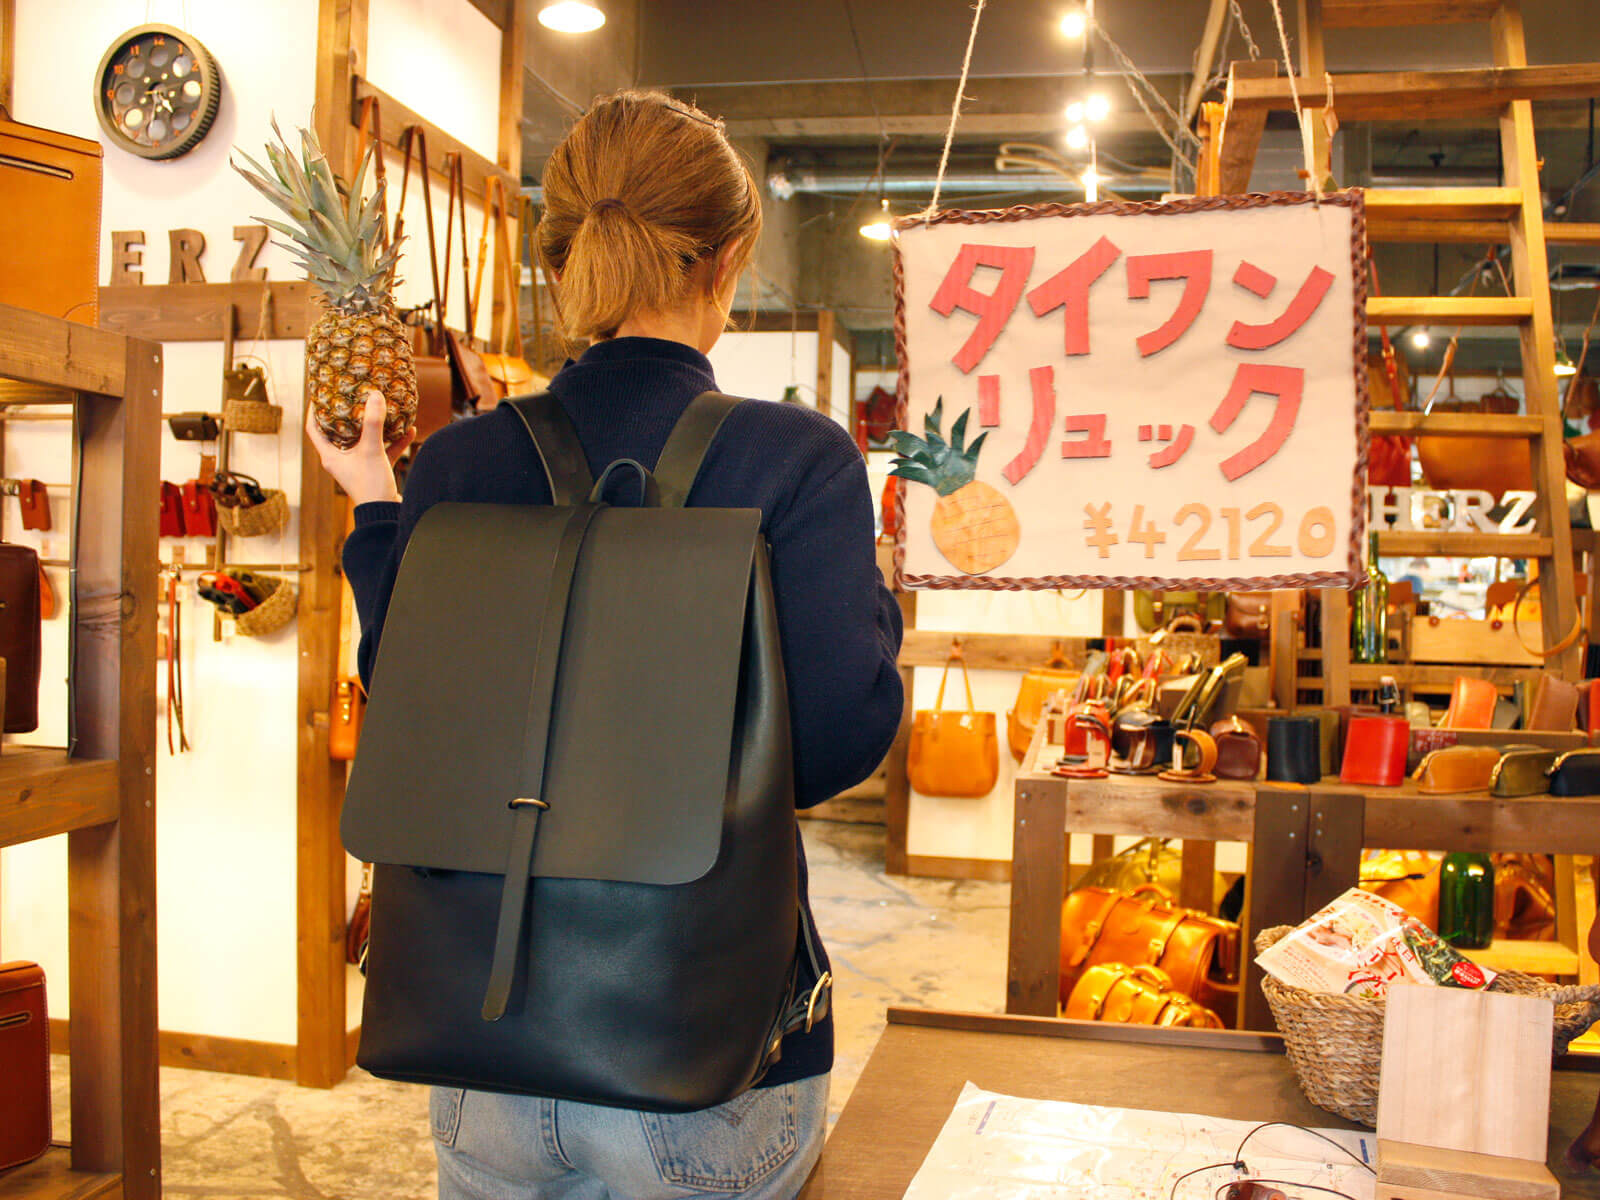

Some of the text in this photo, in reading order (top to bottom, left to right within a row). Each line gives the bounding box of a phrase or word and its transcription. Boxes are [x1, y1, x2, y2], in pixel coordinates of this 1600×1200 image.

[130, 44, 140, 56] 11
[177, 43, 184, 55] 1
[113, 63, 125, 76] 10
[190, 59, 200, 73] 2
[928, 235, 1336, 375] タイワン
[977, 362, 1305, 486] リュック
[1369, 486, 1537, 534] HERZ
[1083, 502, 1336, 560] ¥42120
